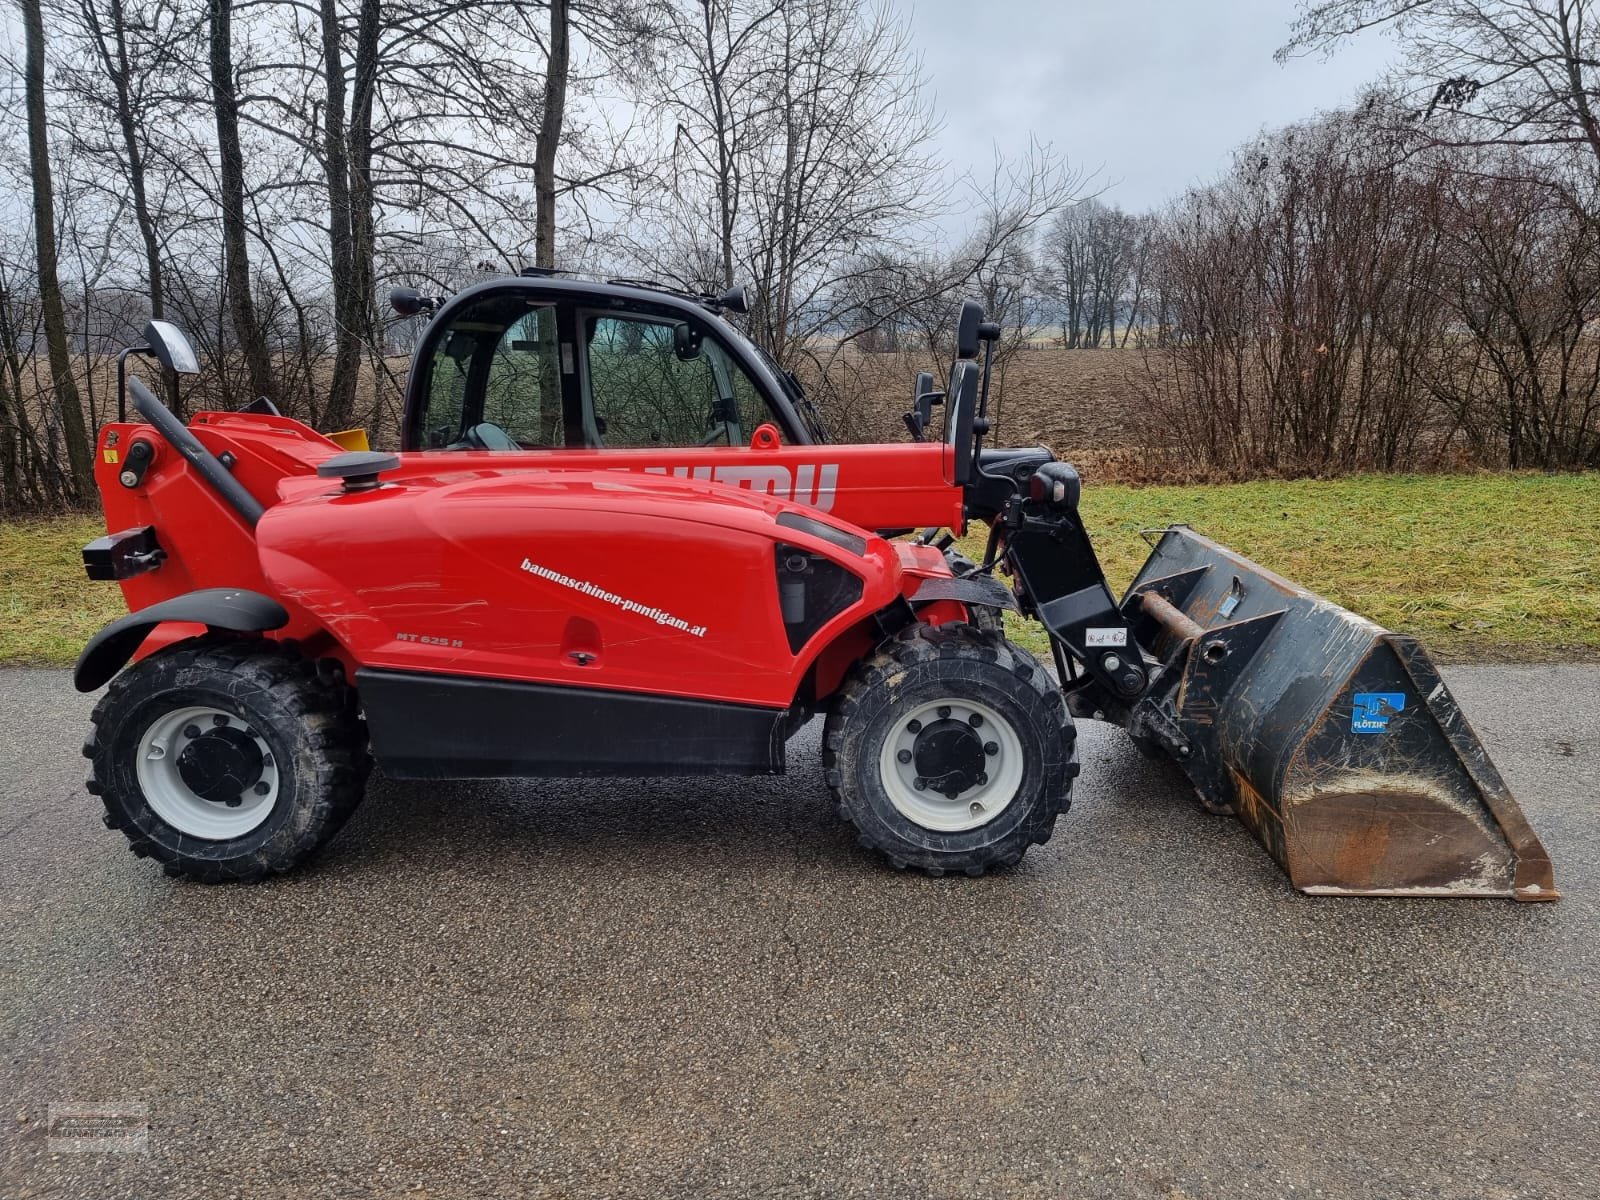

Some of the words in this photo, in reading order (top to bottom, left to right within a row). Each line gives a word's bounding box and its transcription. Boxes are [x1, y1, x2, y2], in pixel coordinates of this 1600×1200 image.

[520, 558, 708, 638] baumaschinen-puntigam.at
[396, 632, 419, 642] MT
[420, 636, 449, 646] 625
[451, 639, 463, 648] H
